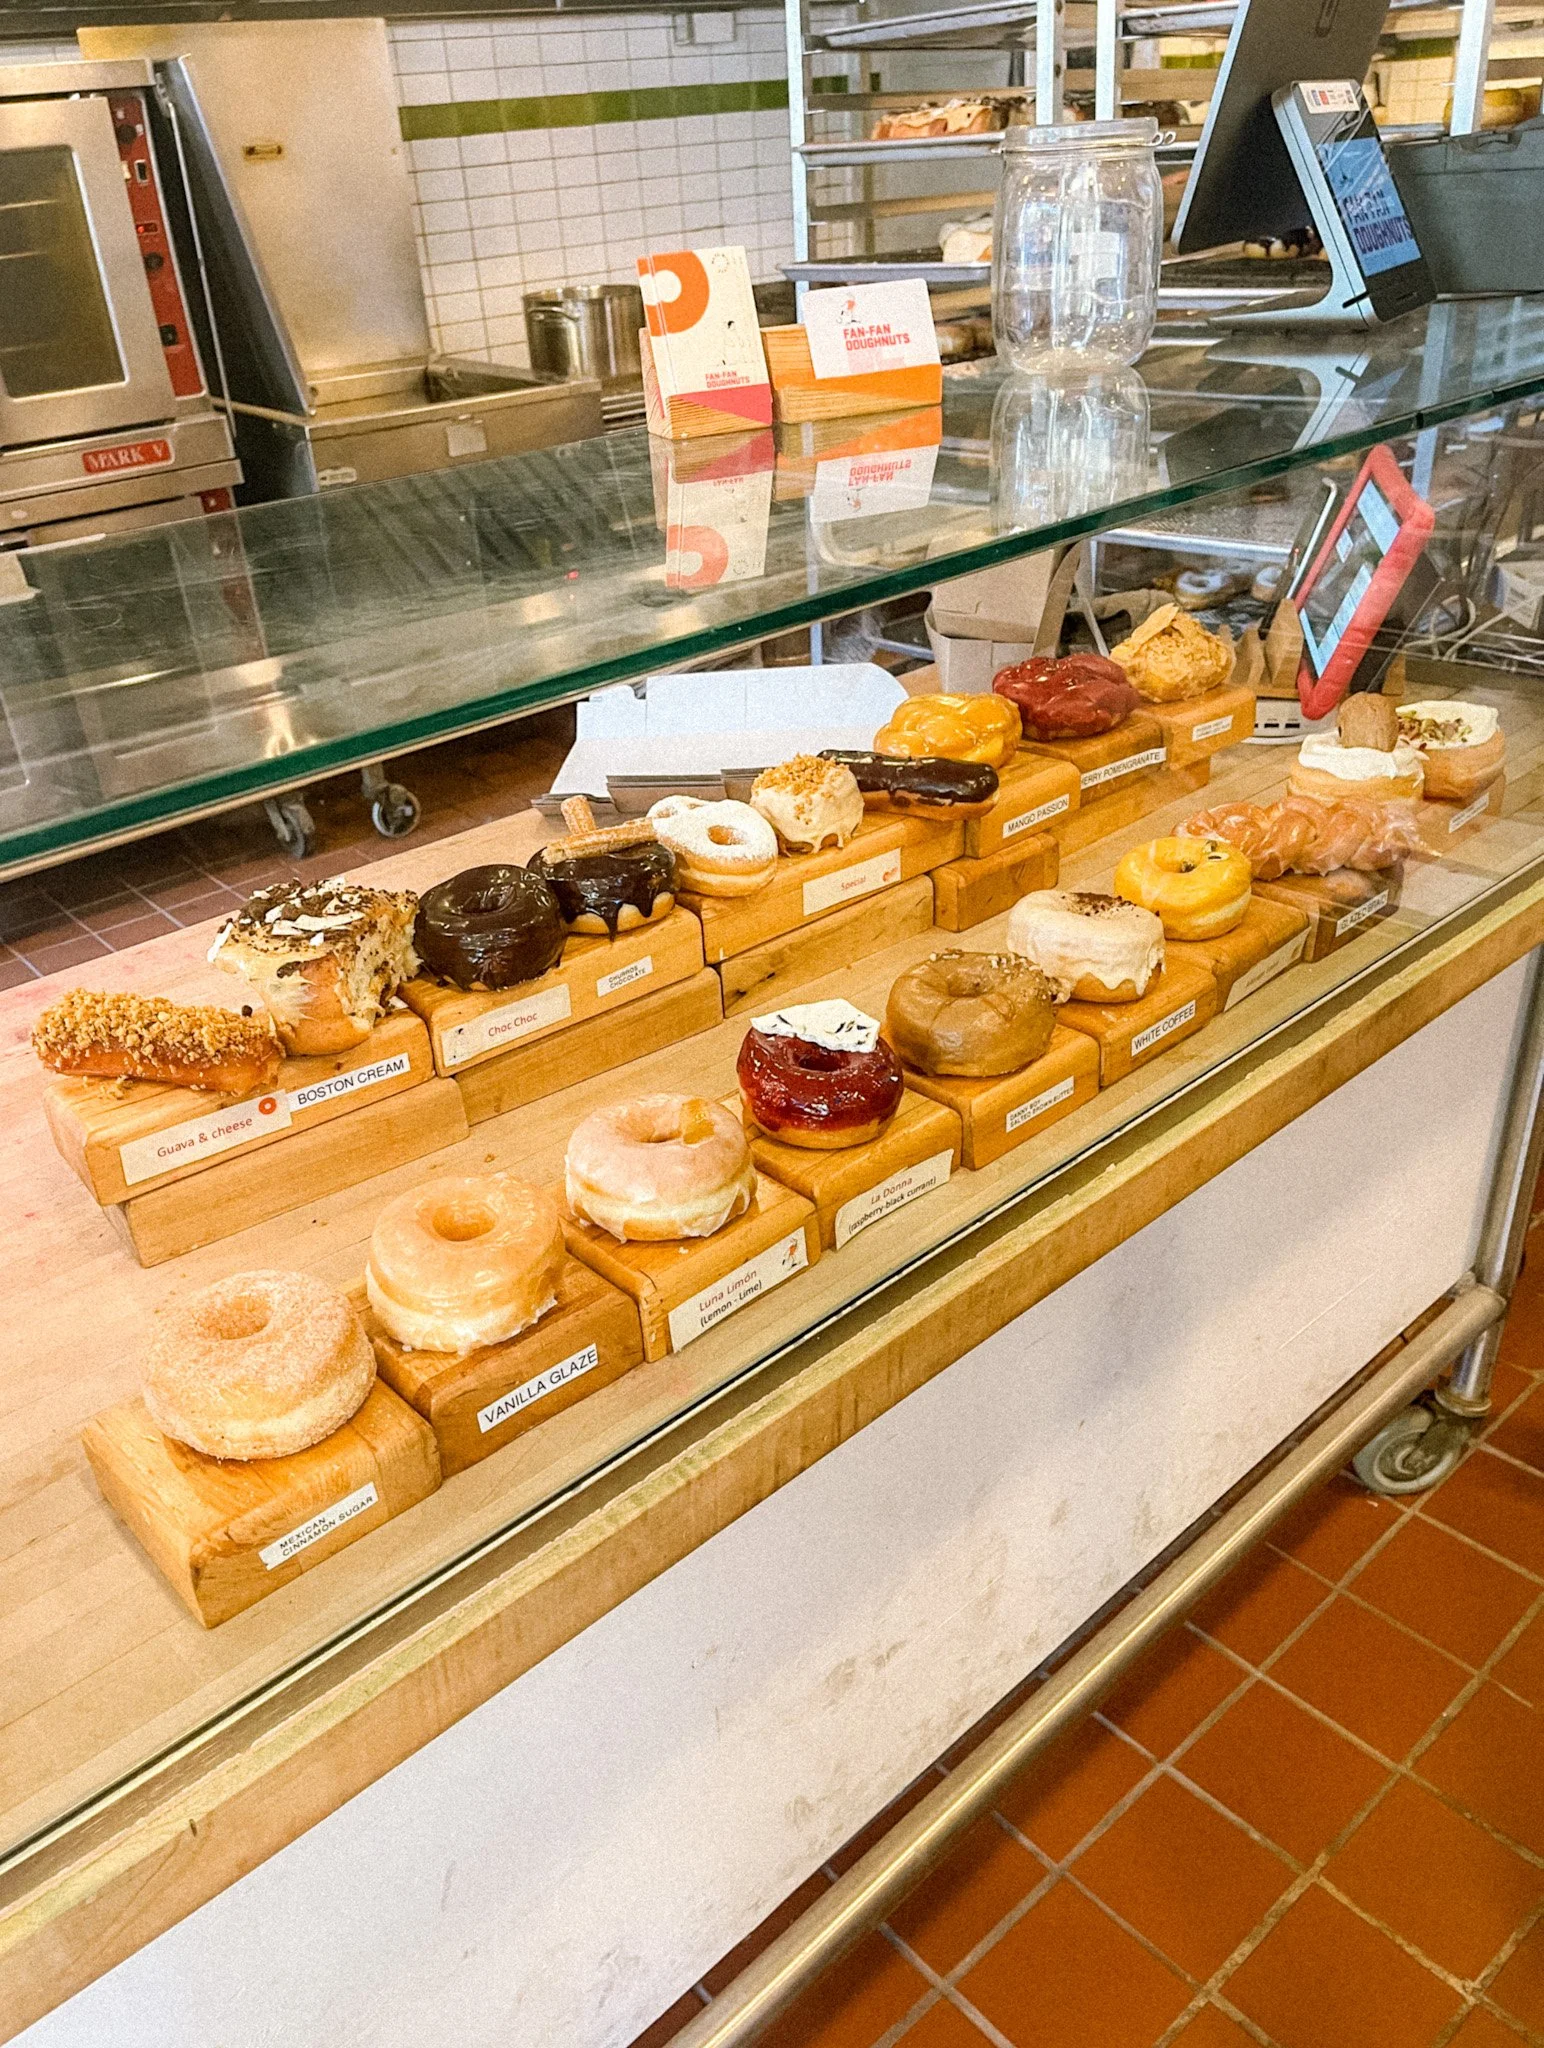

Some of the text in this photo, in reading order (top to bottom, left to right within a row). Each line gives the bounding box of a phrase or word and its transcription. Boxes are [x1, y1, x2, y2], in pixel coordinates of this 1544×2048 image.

[842, 324, 891, 339] FAN-FAN
[845, 333, 911, 351] DOUGHNUTS
[87, 443, 164, 470] MARK V
[1008, 798, 1068, 832] MANGO PASSION
[608, 965, 638, 983] CHURROS
[609, 967, 646, 989] CHOCOLATE
[488, 1012, 538, 1037] Choc Choc
[1134, 1004, 1194, 1050] WHITE COFFEE
[297, 1059, 405, 1105] BOSTON CREAM
[157, 1117, 253, 1158] Guava & cheese
[871, 1177, 913, 1205] La Donna
[699, 1292, 724, 1312] Luna
[700, 1300, 732, 1327] (Lemon
[738, 1279, 762, 1301] Lime)
[484, 1348, 597, 1424] VANILLA GLAZE
[279, 1517, 326, 1550] MEXICAN
[282, 1495, 373, 1557] CINNAMON SUGAR
